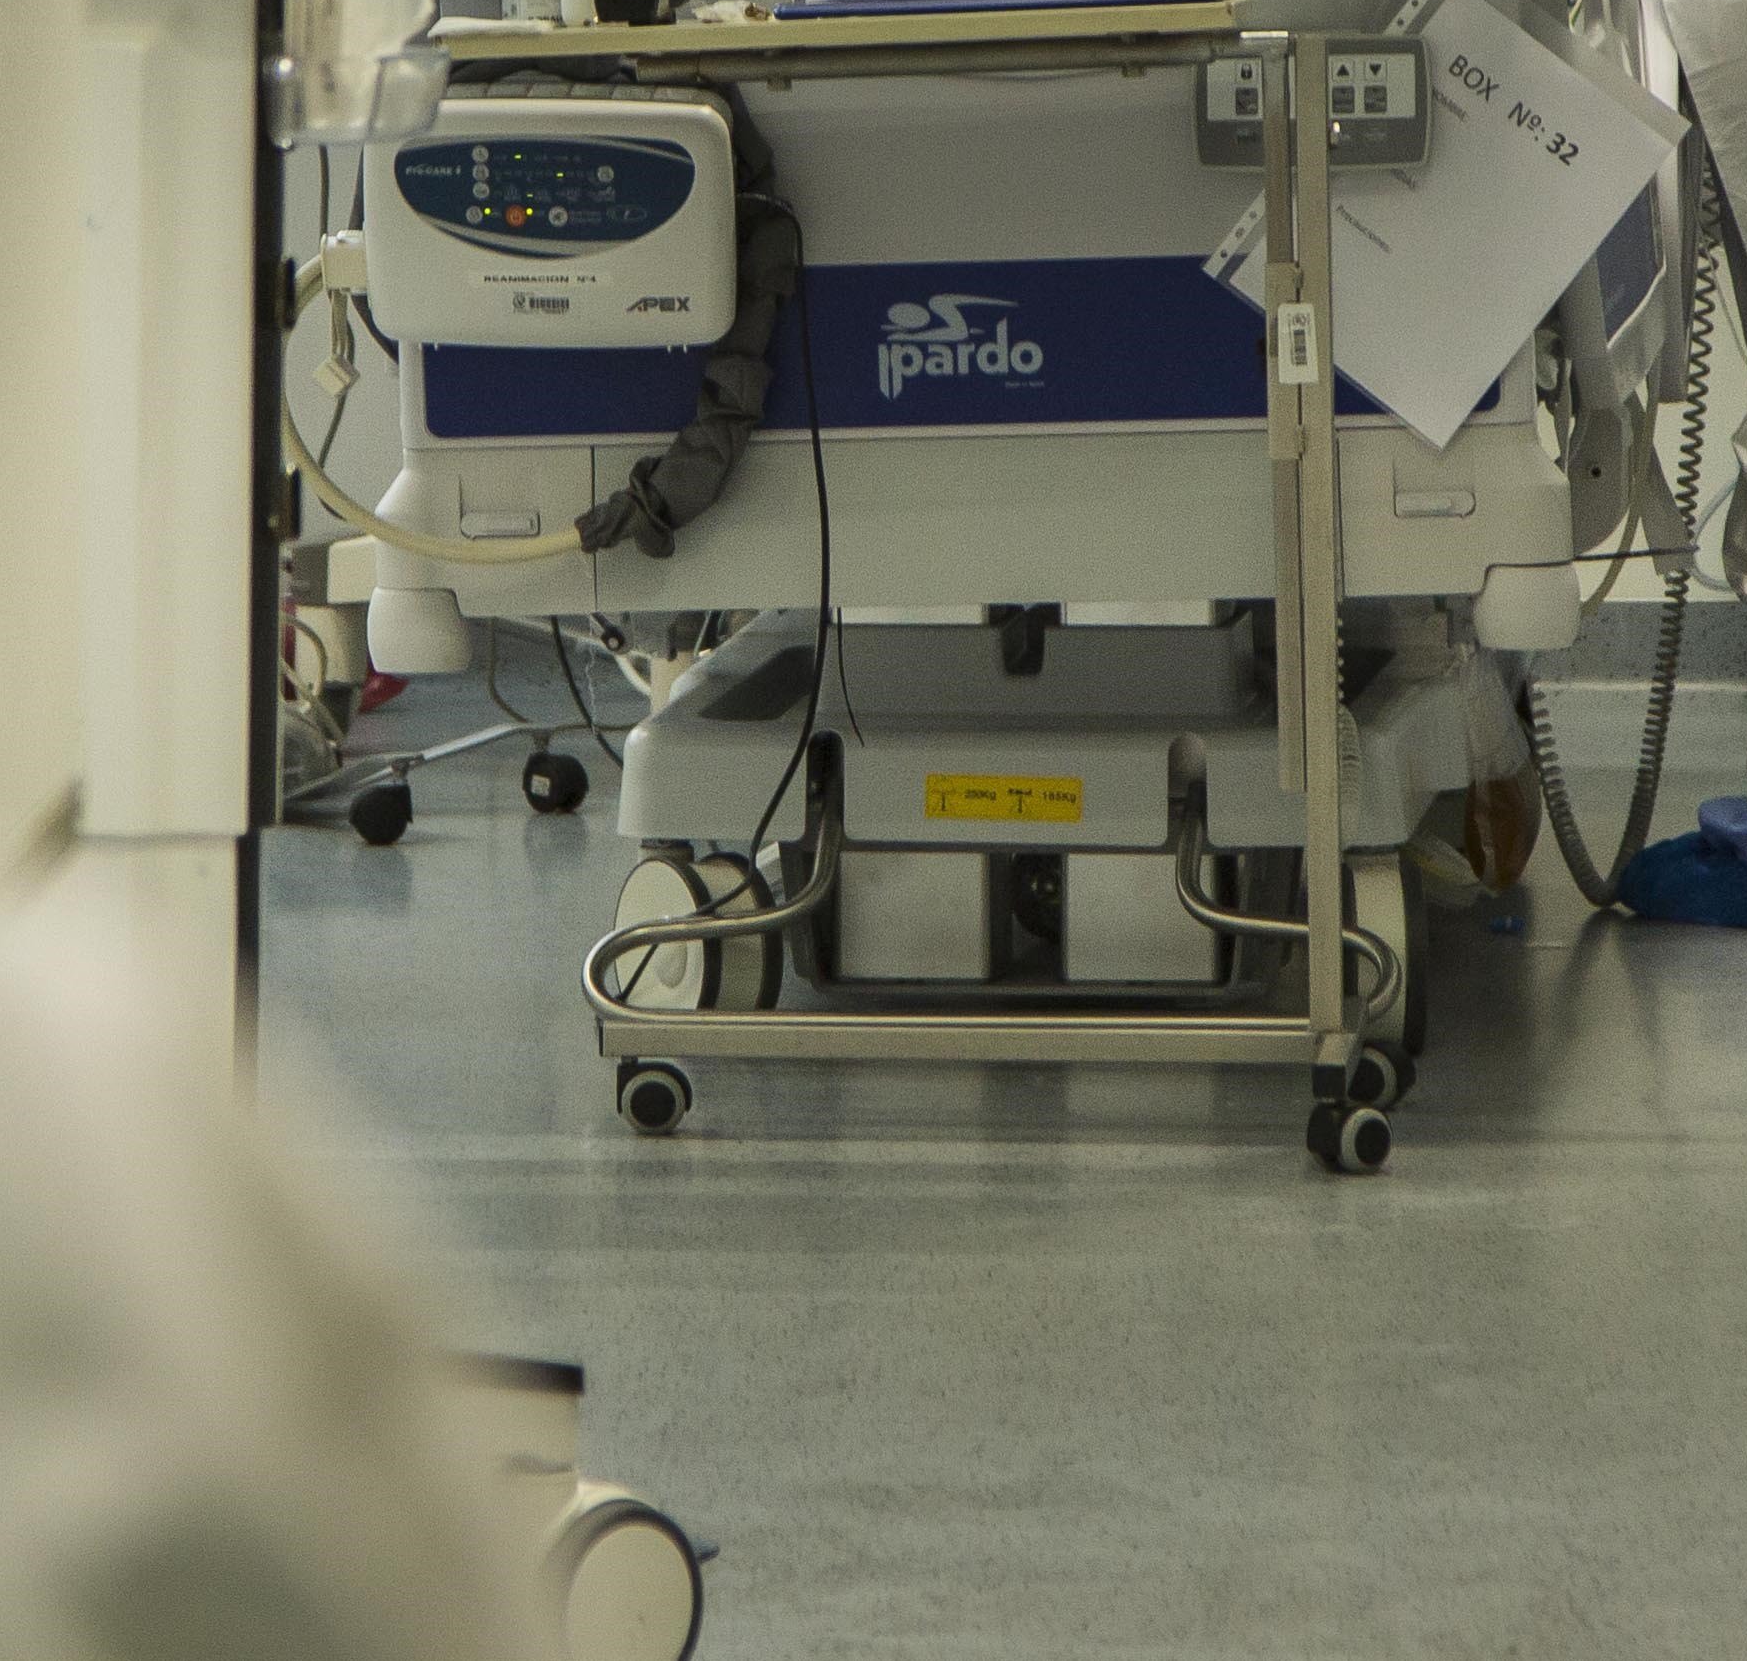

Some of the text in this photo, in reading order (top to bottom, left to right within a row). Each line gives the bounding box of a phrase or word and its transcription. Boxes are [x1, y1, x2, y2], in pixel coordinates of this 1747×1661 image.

[1449, 54, 1500, 102] BOX
[1545, 131, 1580, 167] 32
[626, 295, 691, 314] APEX
